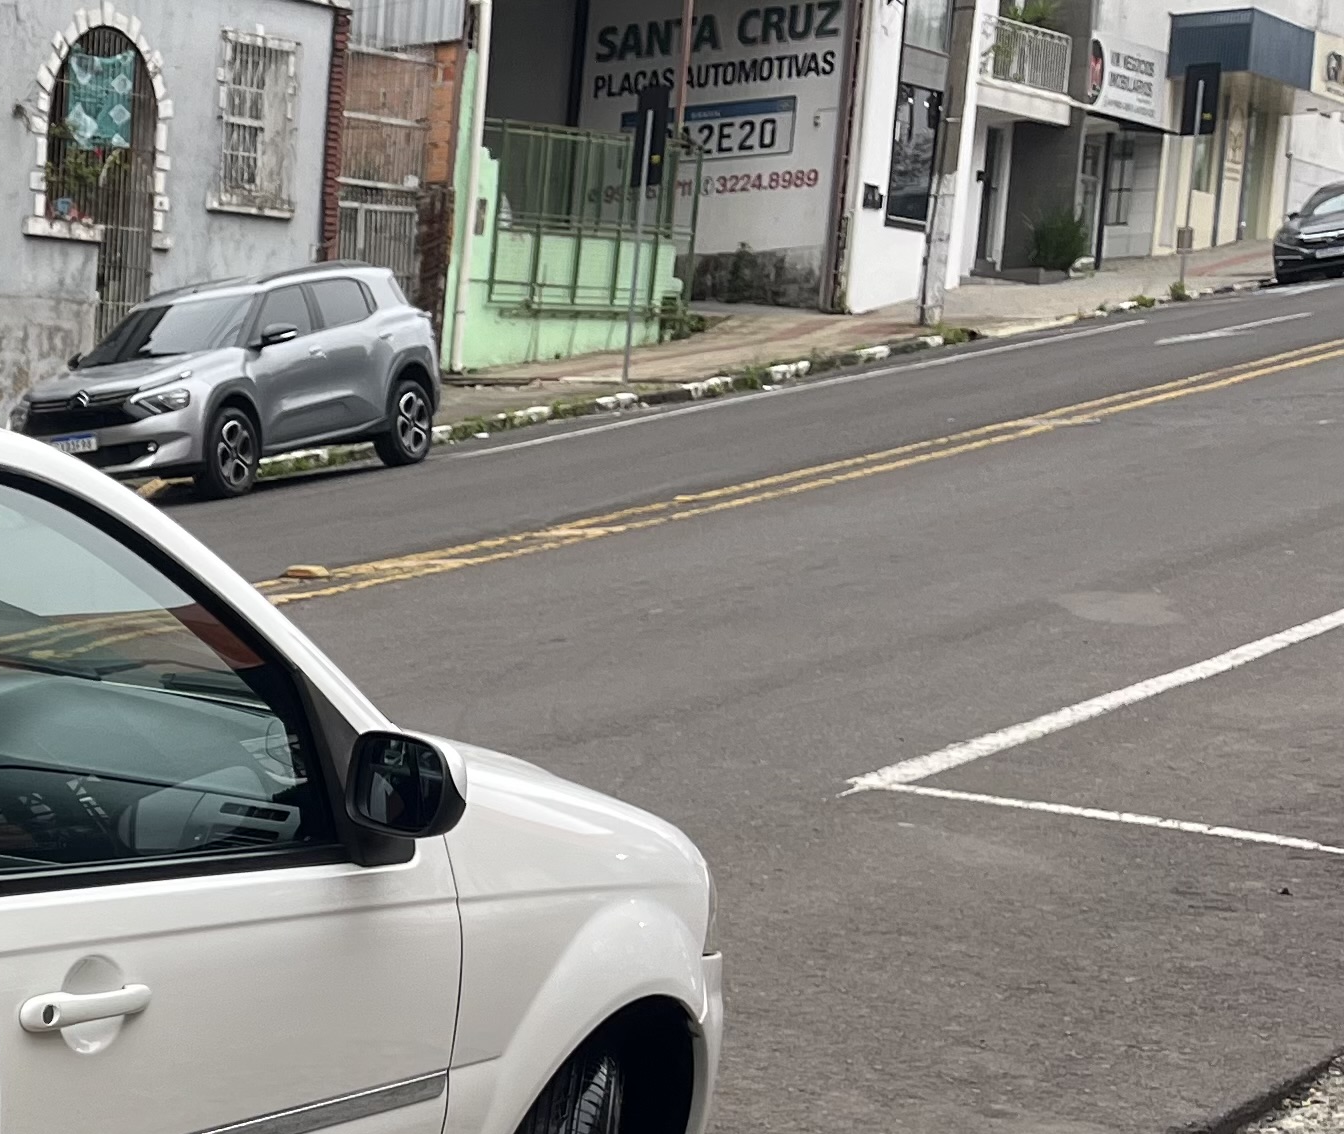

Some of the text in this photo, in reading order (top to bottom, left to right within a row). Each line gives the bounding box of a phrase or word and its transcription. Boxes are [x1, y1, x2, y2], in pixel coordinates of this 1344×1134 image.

[737, 1, 842, 46] CRUZ
[686, 50, 836, 89] AUTOMOTIVAS
[715, 168, 820, 195] 3224.8989
